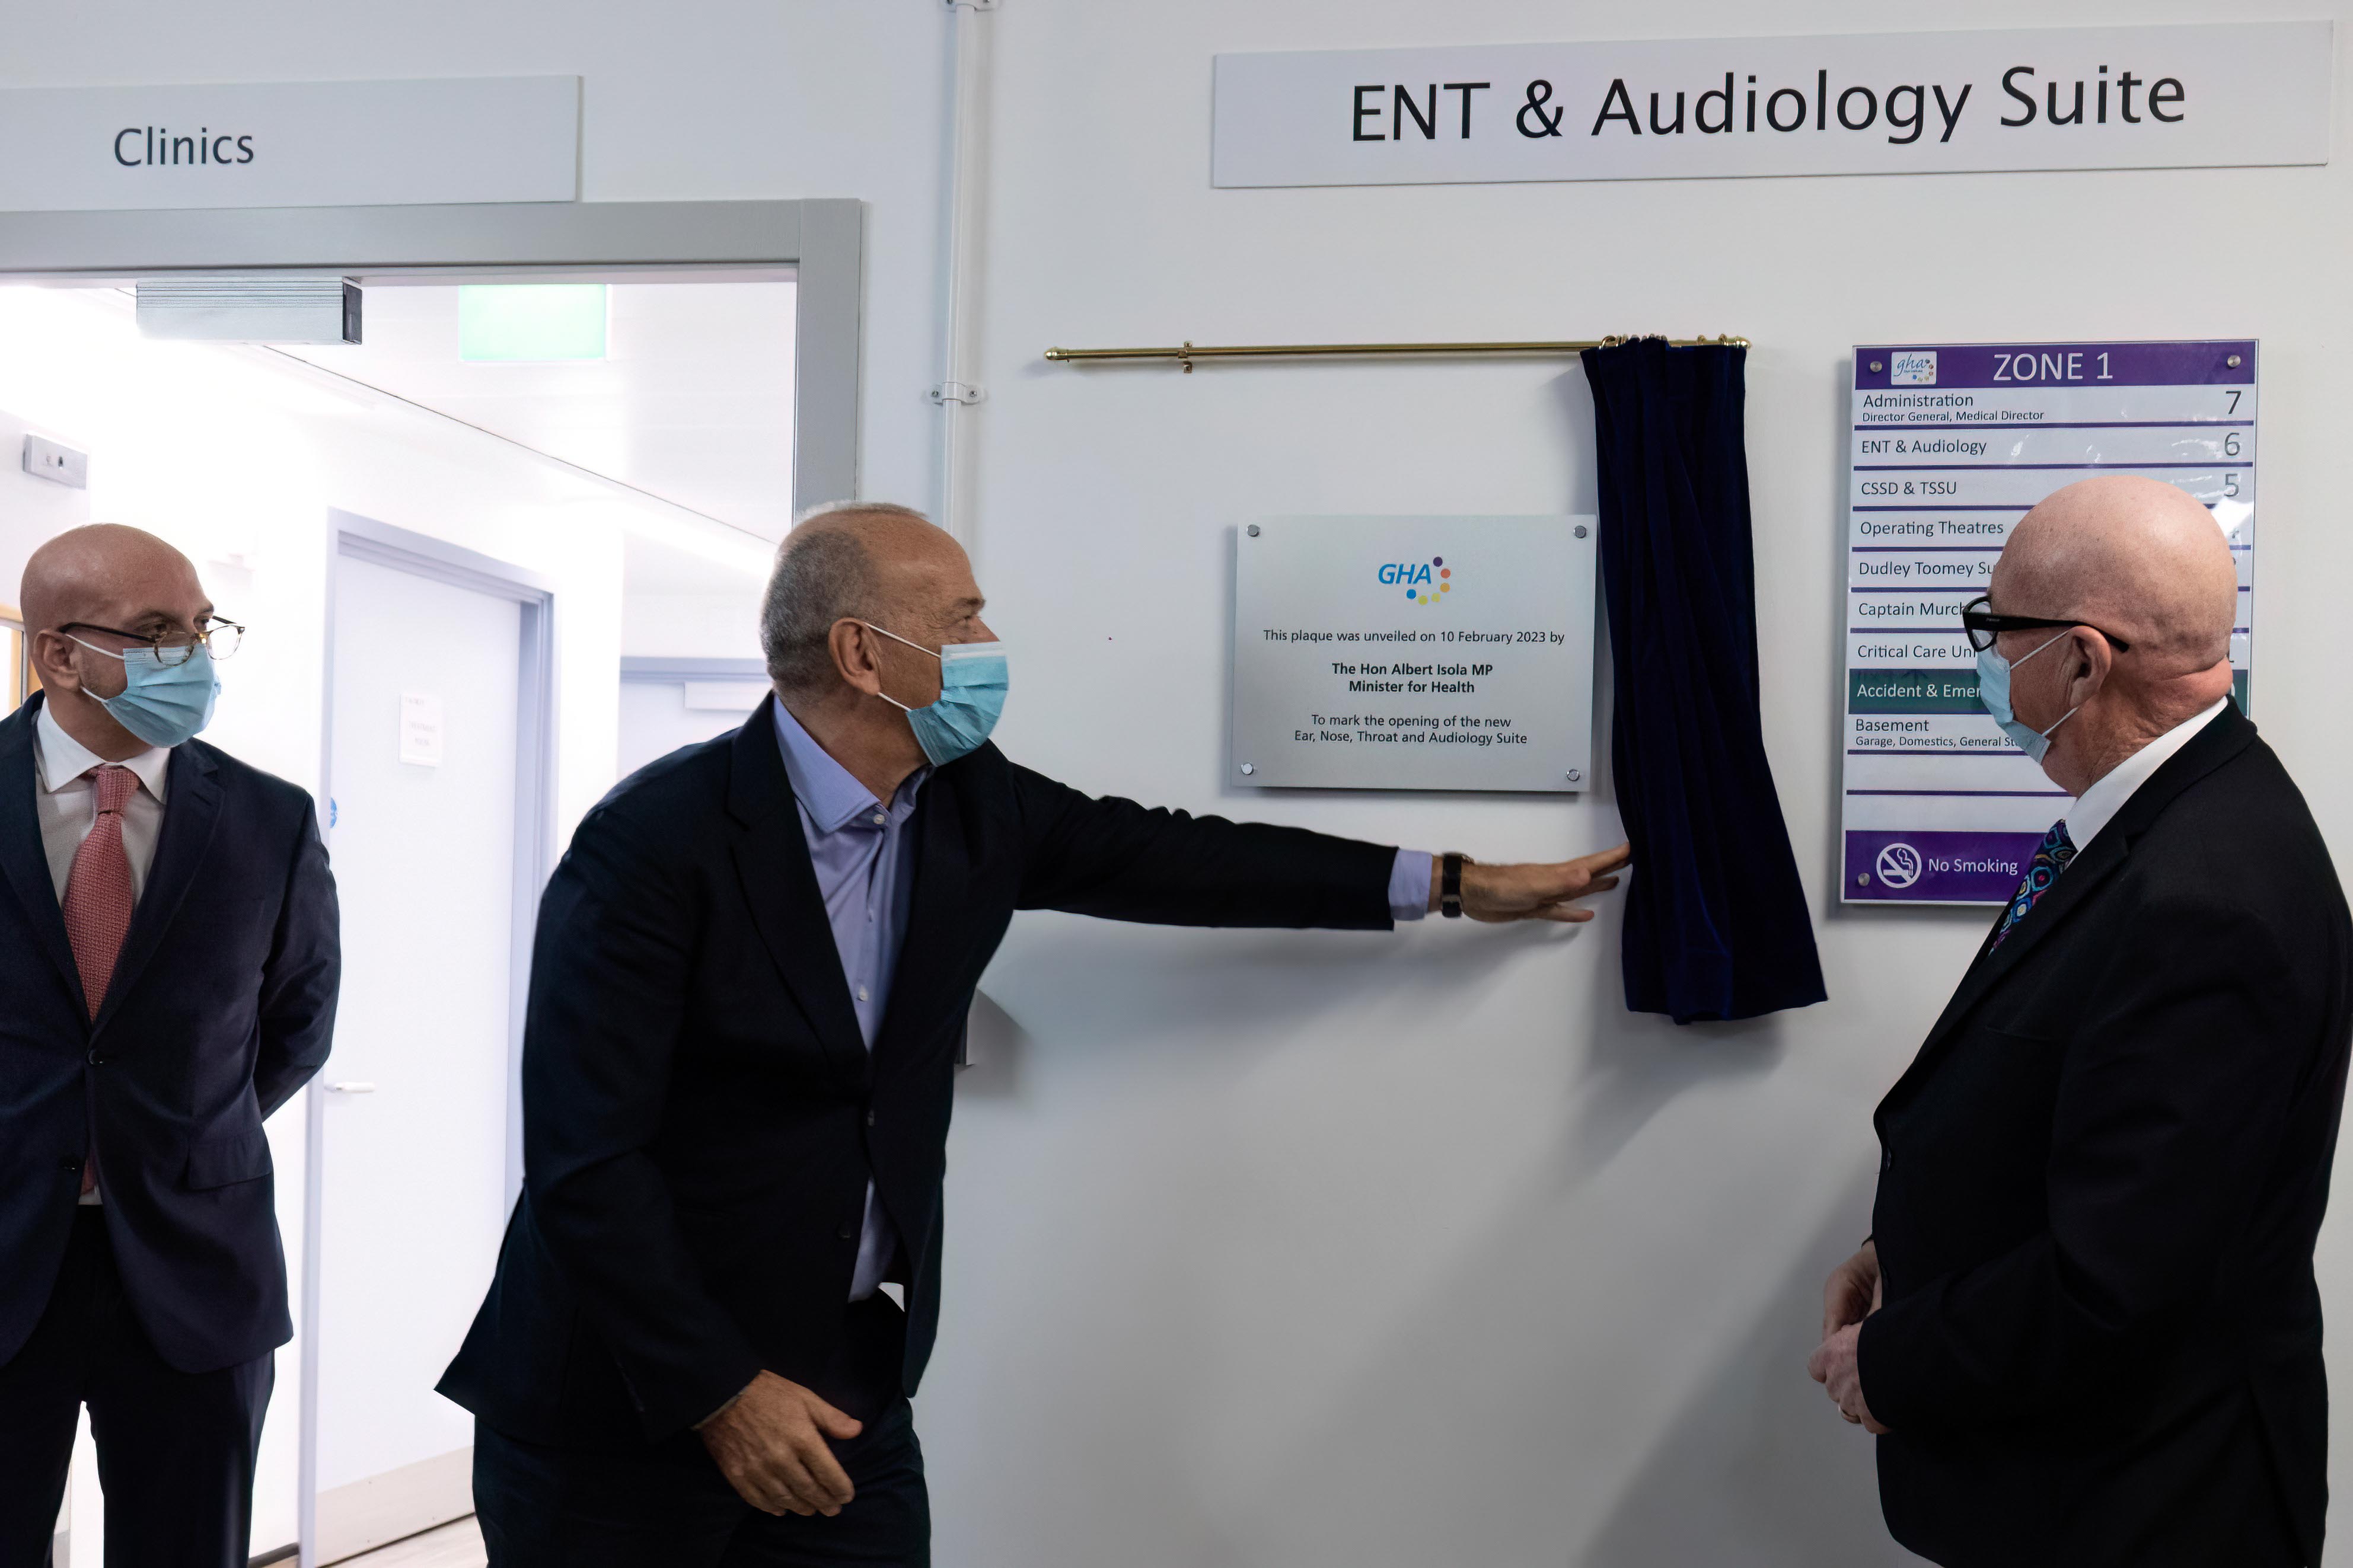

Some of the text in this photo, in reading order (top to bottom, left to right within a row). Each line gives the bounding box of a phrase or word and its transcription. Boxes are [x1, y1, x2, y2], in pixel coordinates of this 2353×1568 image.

[1353, 65, 2185, 145] ENT & Audiology Suite
[114, 126, 254, 167] Clinics
[1893, 352, 1927, 377] gha
[1993, 352, 2113, 381] ZONE 1
[1863, 393, 1973, 408] Administration
[2226, 390, 2242, 415] 7
[1863, 410, 2044, 423] Director General, Medical Director
[1862, 439, 1987, 455] ENT & Audiology
[2224, 432, 2240, 456] 6
[1861, 481, 1956, 495] CSSD & TSSU
[2224, 473, 2239, 498] 5
[1860, 520, 2004, 538] Operating Theatres
[1378, 563, 1431, 585] GHA
[1860, 561, 1911, 578] Dudley
[1914, 561, 1974, 578] Toomey
[1858, 602, 1914, 619] Captain
[1263, 629, 1565, 646] This plaque was unveiled on 10 February 2023 by
[1858, 644, 1908, 658] Critical
[1913, 645, 1946, 658] Care
[1331, 662, 1493, 676] The Hon Albert Isola MP
[1349, 680, 1475, 693] Minister for Health
[1857, 683, 1922, 697] Accident
[1926, 684, 1938, 697] &
[1311, 714, 1512, 729] To mark the opening of the new
[1856, 718, 1930, 732] Basement
[1295, 730, 1528, 746] Ear, Nose, Throat and Audiology Suite
[1855, 736, 1896, 748] Garage,
[1899, 736, 1956, 748] Domestics,
[1959, 736, 2001, 747] General
[1928, 858, 2018, 876] No Smoking
